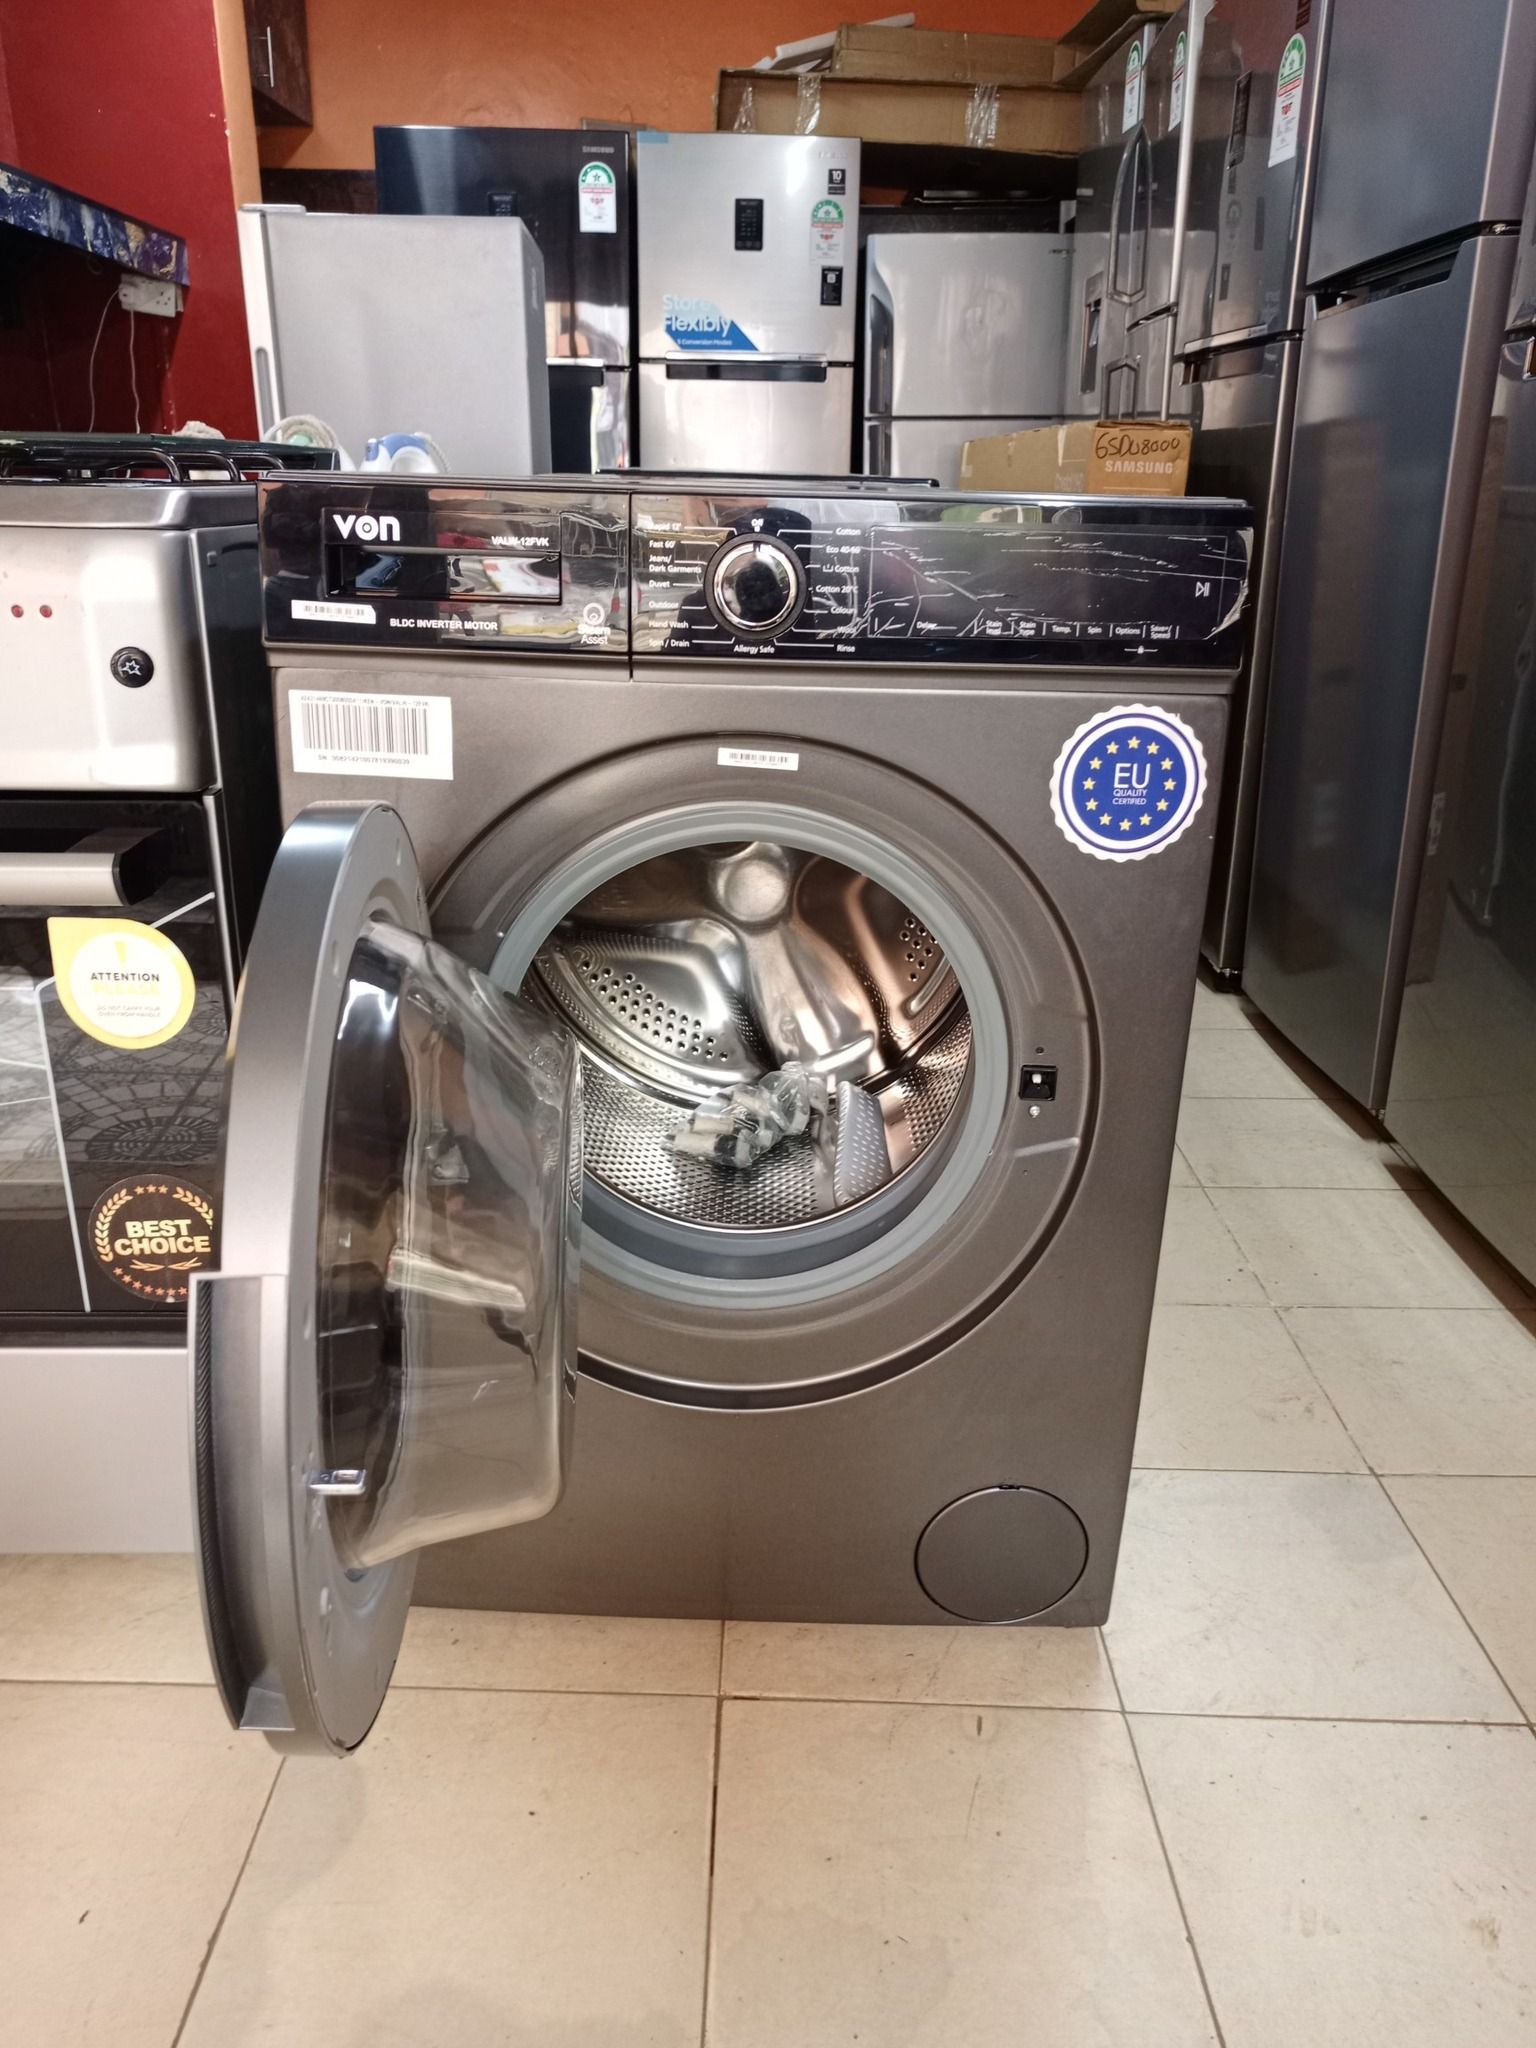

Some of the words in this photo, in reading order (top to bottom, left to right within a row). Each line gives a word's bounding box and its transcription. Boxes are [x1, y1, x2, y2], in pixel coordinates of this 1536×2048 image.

[832, 171, 842, 180] 10
[663, 295, 711, 311] Store
[665, 316, 732, 337] Flexibly
[1104, 461, 1173, 474] SAMSUNG
[751, 518, 764, 526] Off
[836, 527, 861, 535] Cotton
[649, 540, 664, 548] Fast
[826, 545, 839, 553] Eco
[840, 545, 861, 554] 40-60
[649, 555, 672, 563] Jeans/
[649, 564, 666, 572] Dark
[668, 565, 702, 573] Garments
[835, 565, 859, 573] Cotton
[649, 580, 670, 588] Duvet
[816, 585, 841, 593] Cotton
[649, 601, 679, 609] Outdoor
[390, 618, 415, 628] BLDC
[417, 619, 462, 629] INVERTER
[464, 621, 498, 630] MOTOR
[669, 621, 689, 629] Wash
[1088, 625, 1102, 634] Spin
[1115, 627, 1140, 635] Options
[581, 635, 608, 644] Assist
[671, 639, 690, 647] Drain
[734, 645, 758, 655] Allergy
[760, 645, 775, 654] Safe
[836, 644, 856, 653] Rinse
[1114, 763, 1151, 789] EU
[1113, 789, 1148, 797] QUALITY
[91, 972, 160, 982] ATTENTION
[125, 1219, 192, 1238] BEST
[114, 1235, 211, 1256] CHOICE
